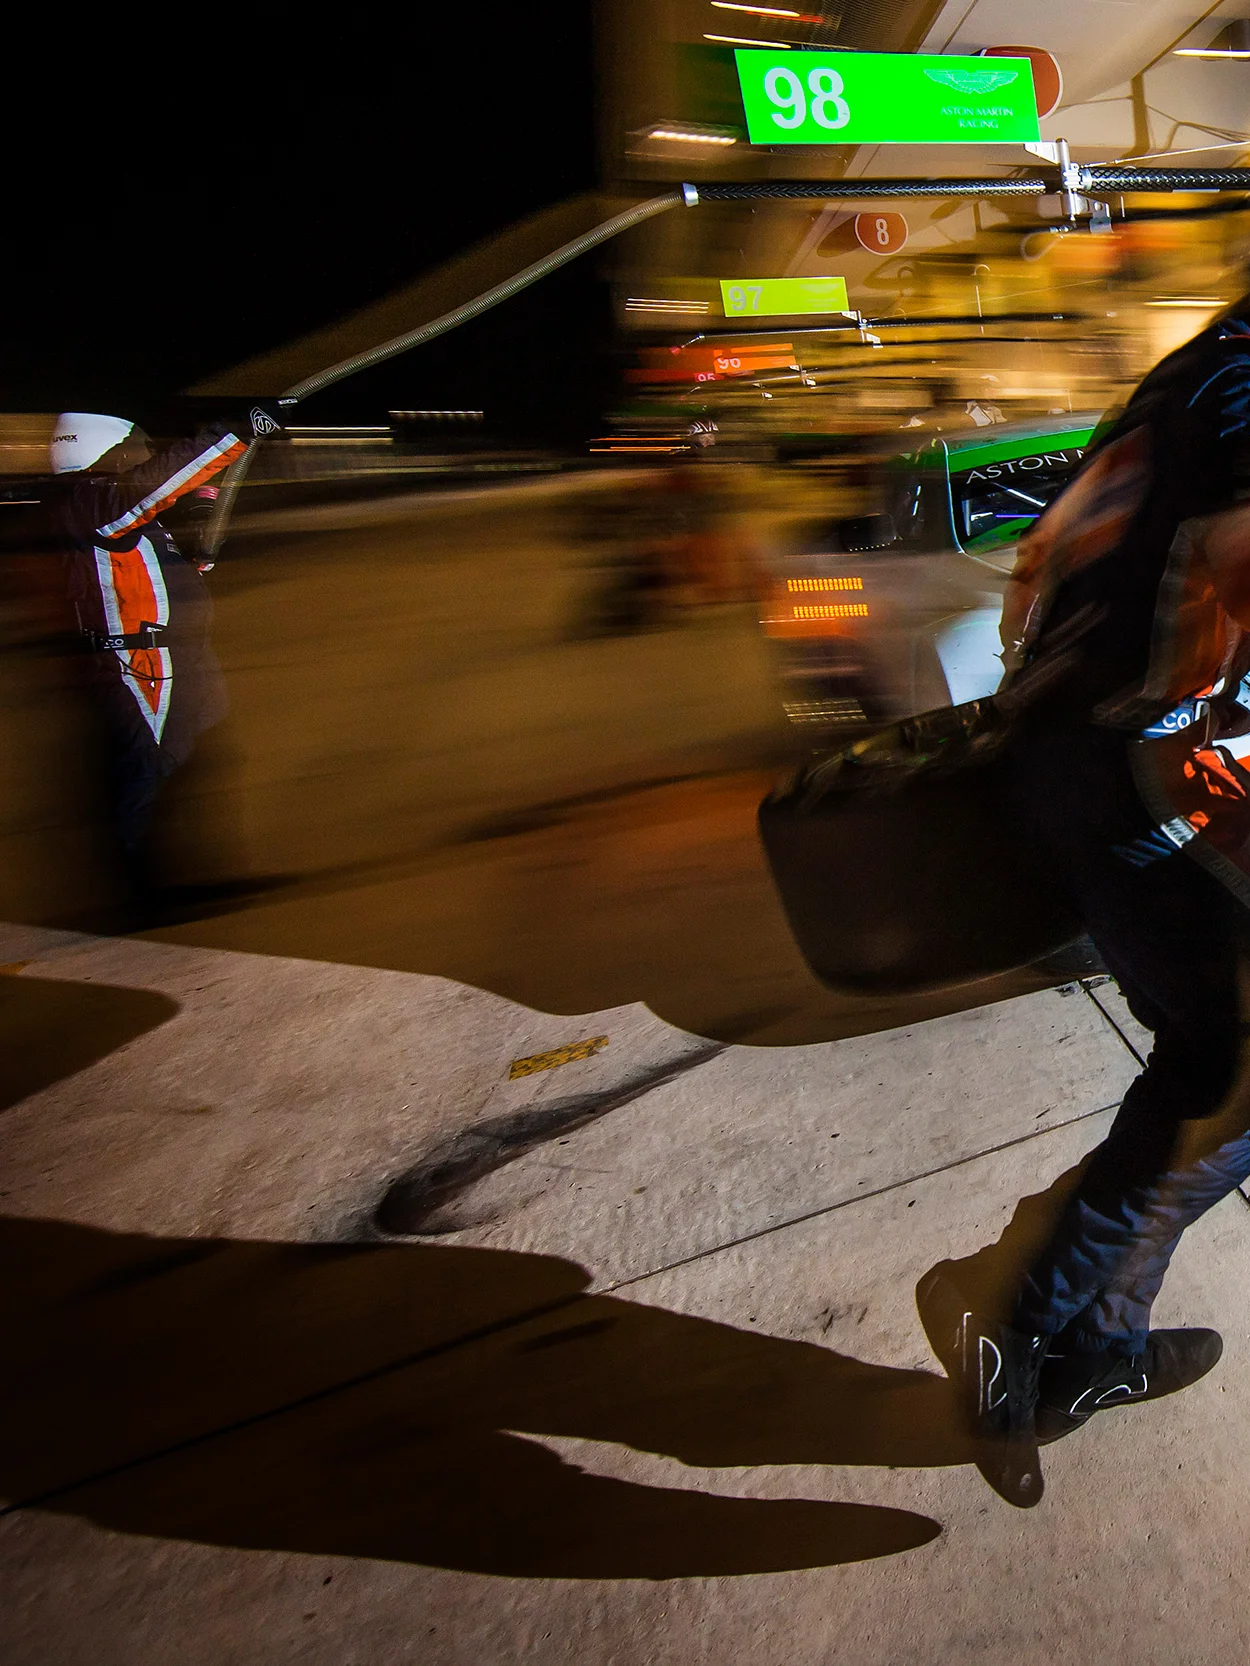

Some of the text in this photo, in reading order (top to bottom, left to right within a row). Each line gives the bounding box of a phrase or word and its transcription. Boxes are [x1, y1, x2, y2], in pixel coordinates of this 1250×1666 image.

[763, 66, 851, 129] 98
[940, 106, 1014, 117] ASTON MARTIN
[959, 119, 999, 129] RACING
[875, 218, 890, 246] 8
[727, 285, 763, 312] 97
[53, 434, 78, 443] uvex
[966, 451, 1069, 485] ASTON
